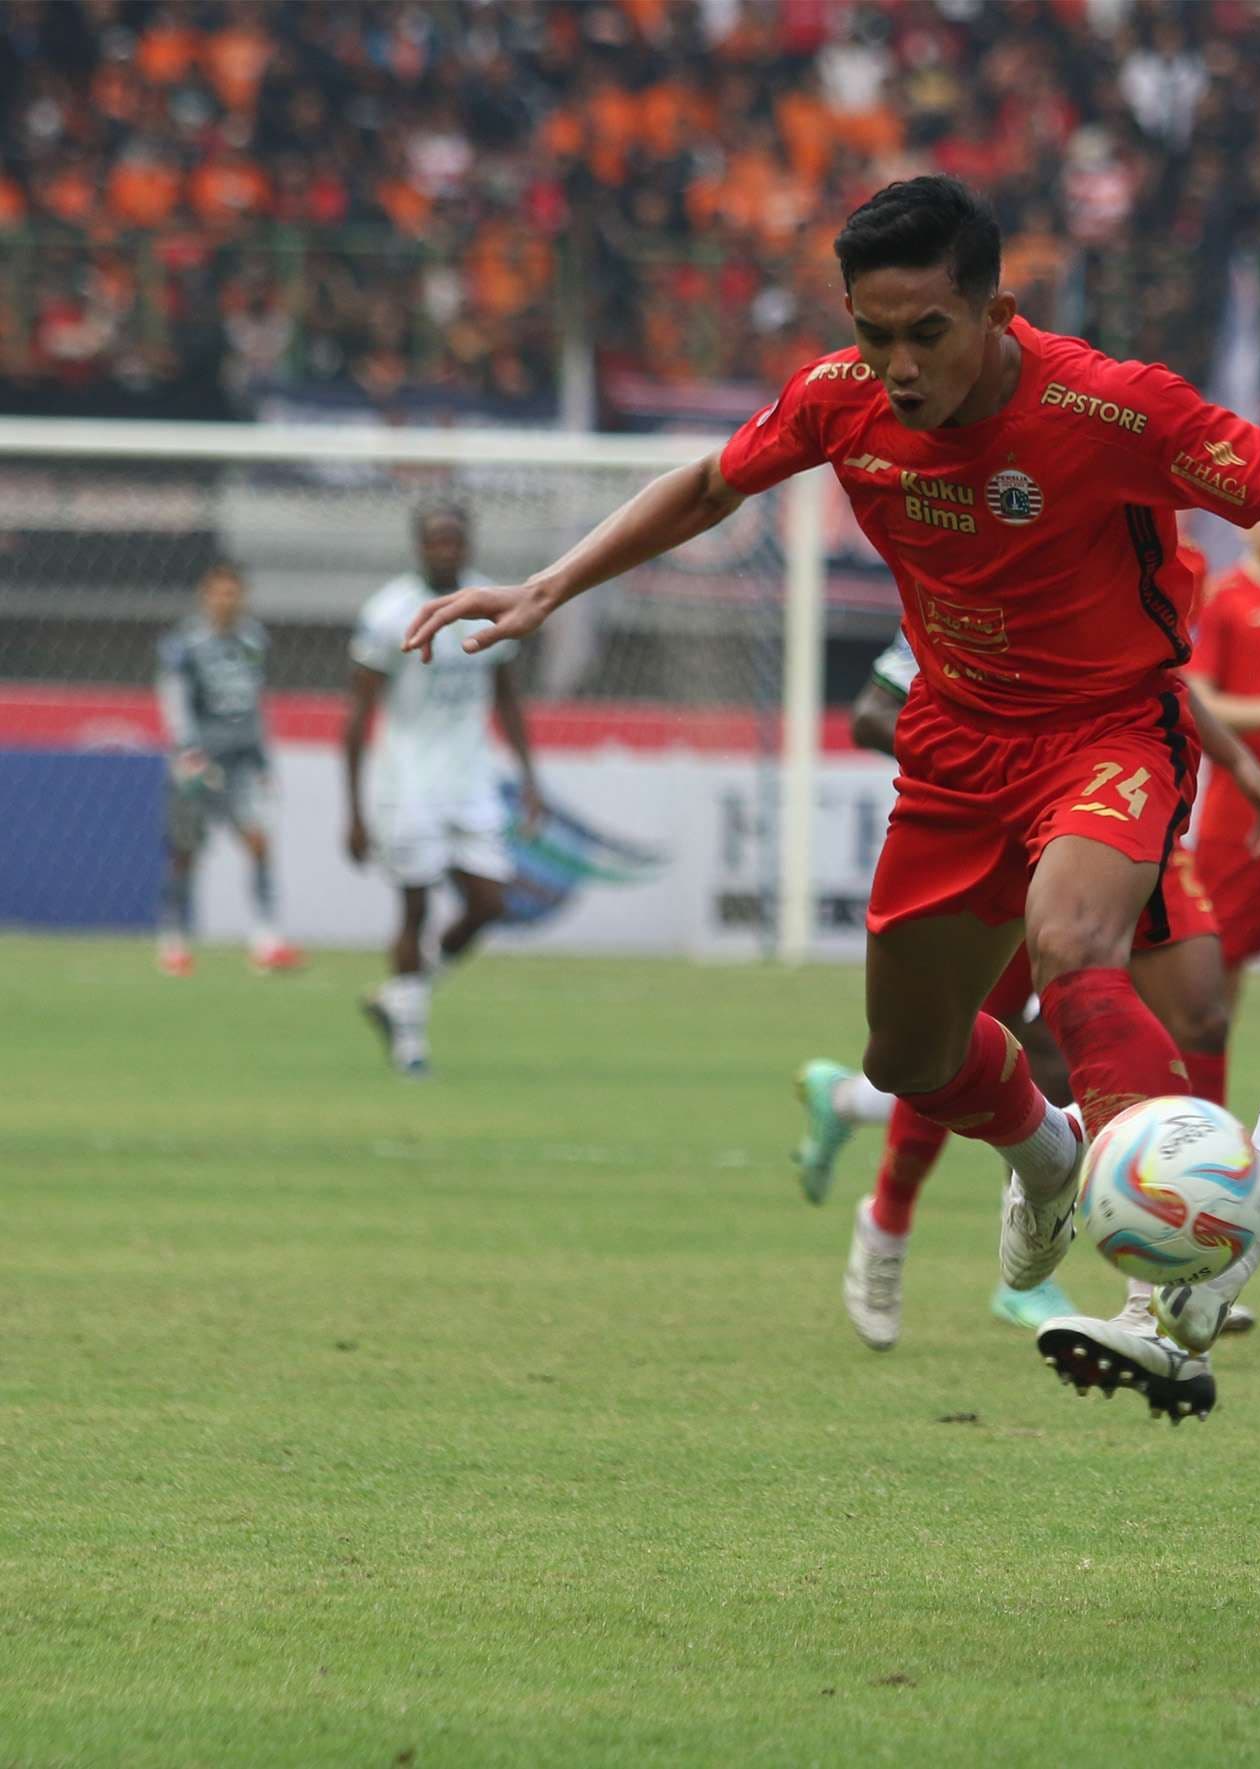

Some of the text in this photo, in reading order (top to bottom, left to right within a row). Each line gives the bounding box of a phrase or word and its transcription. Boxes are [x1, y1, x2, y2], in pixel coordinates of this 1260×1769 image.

[900, 469, 975, 506] Kuku
[1174, 450, 1248, 500] ITHACA
[904, 495, 977, 534] Bima
